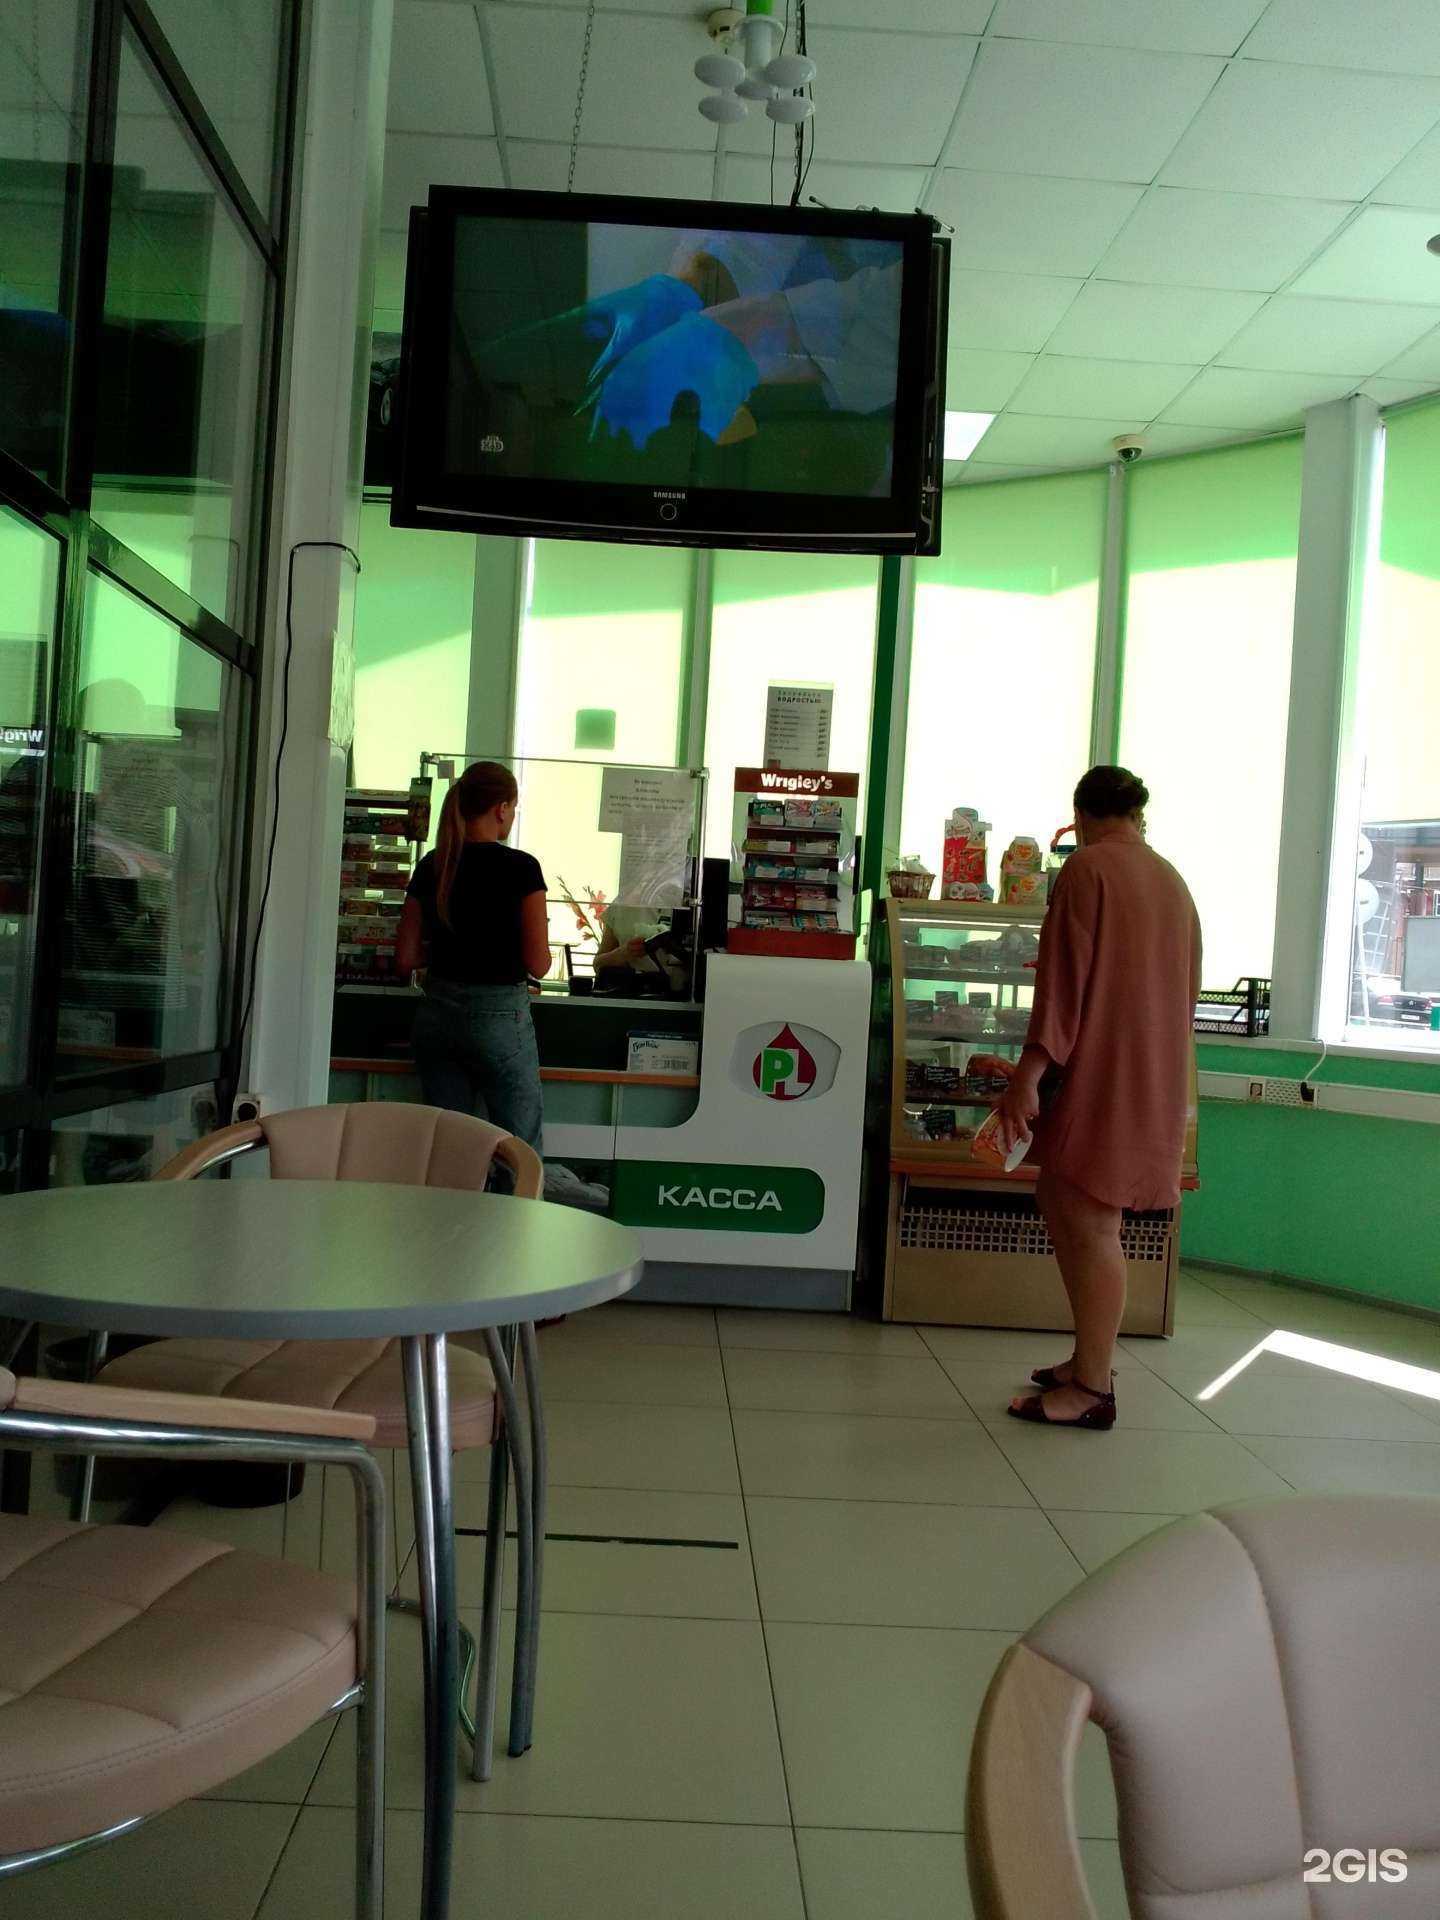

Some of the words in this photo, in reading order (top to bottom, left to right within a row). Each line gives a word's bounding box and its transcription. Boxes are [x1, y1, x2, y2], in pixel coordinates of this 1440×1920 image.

[760, 773, 834, 792] Wrigley's
[760, 1048, 811, 1095] PL
[658, 1185, 783, 1212] КАССА
